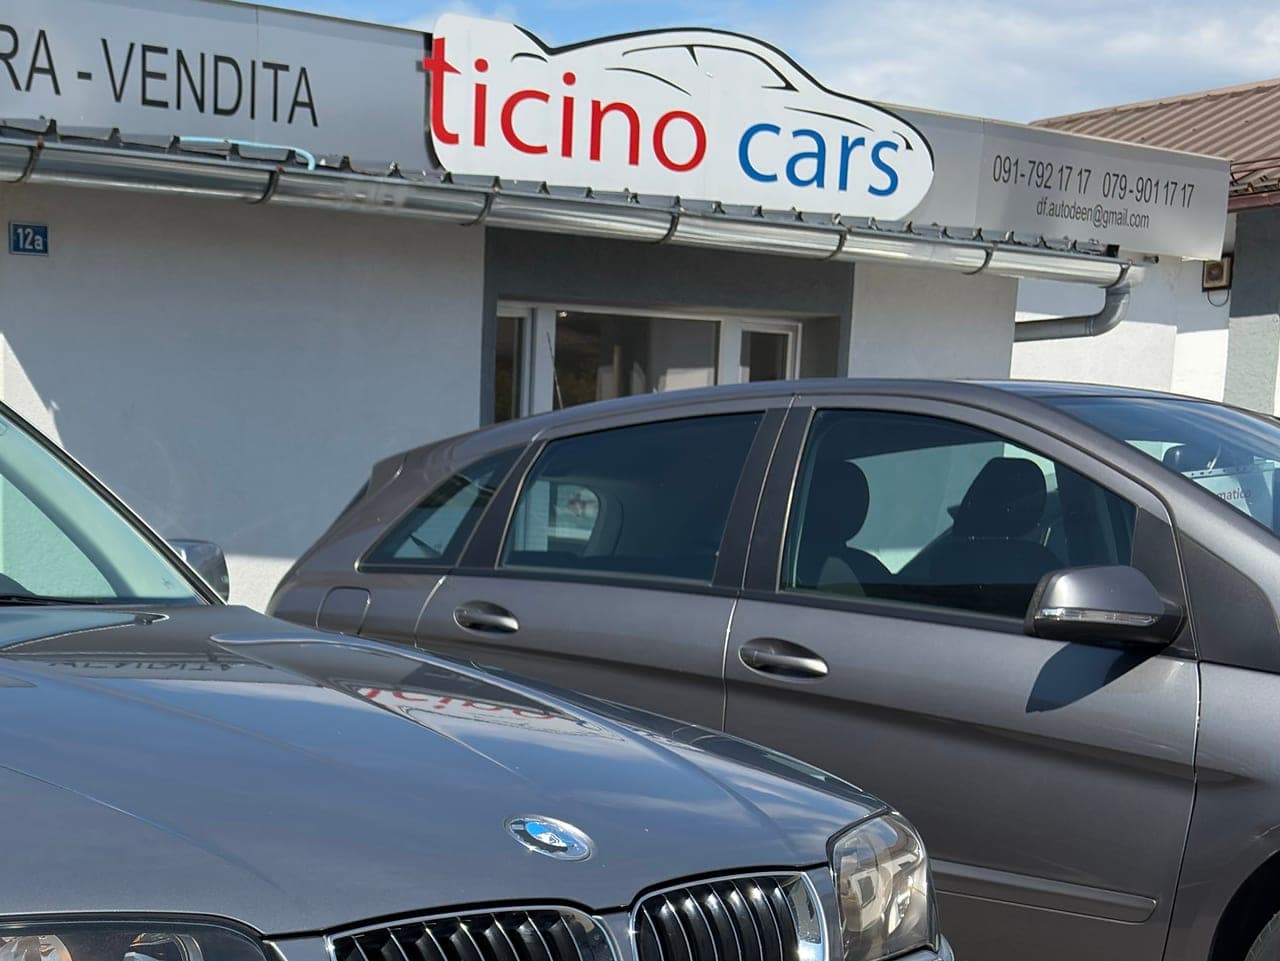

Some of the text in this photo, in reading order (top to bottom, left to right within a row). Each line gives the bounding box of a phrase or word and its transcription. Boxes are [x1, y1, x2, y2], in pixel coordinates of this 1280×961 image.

[100, 38, 319, 128] VENDITA
[422, 36, 901, 197] ticino cars
[992, 154, 1054, 190] 091-792
[1058, 164, 1074, 193] 17
[1076, 167, 1092, 195] 17
[1181, 183, 1196, 209] 17
[16, 227, 44, 251] 12a
